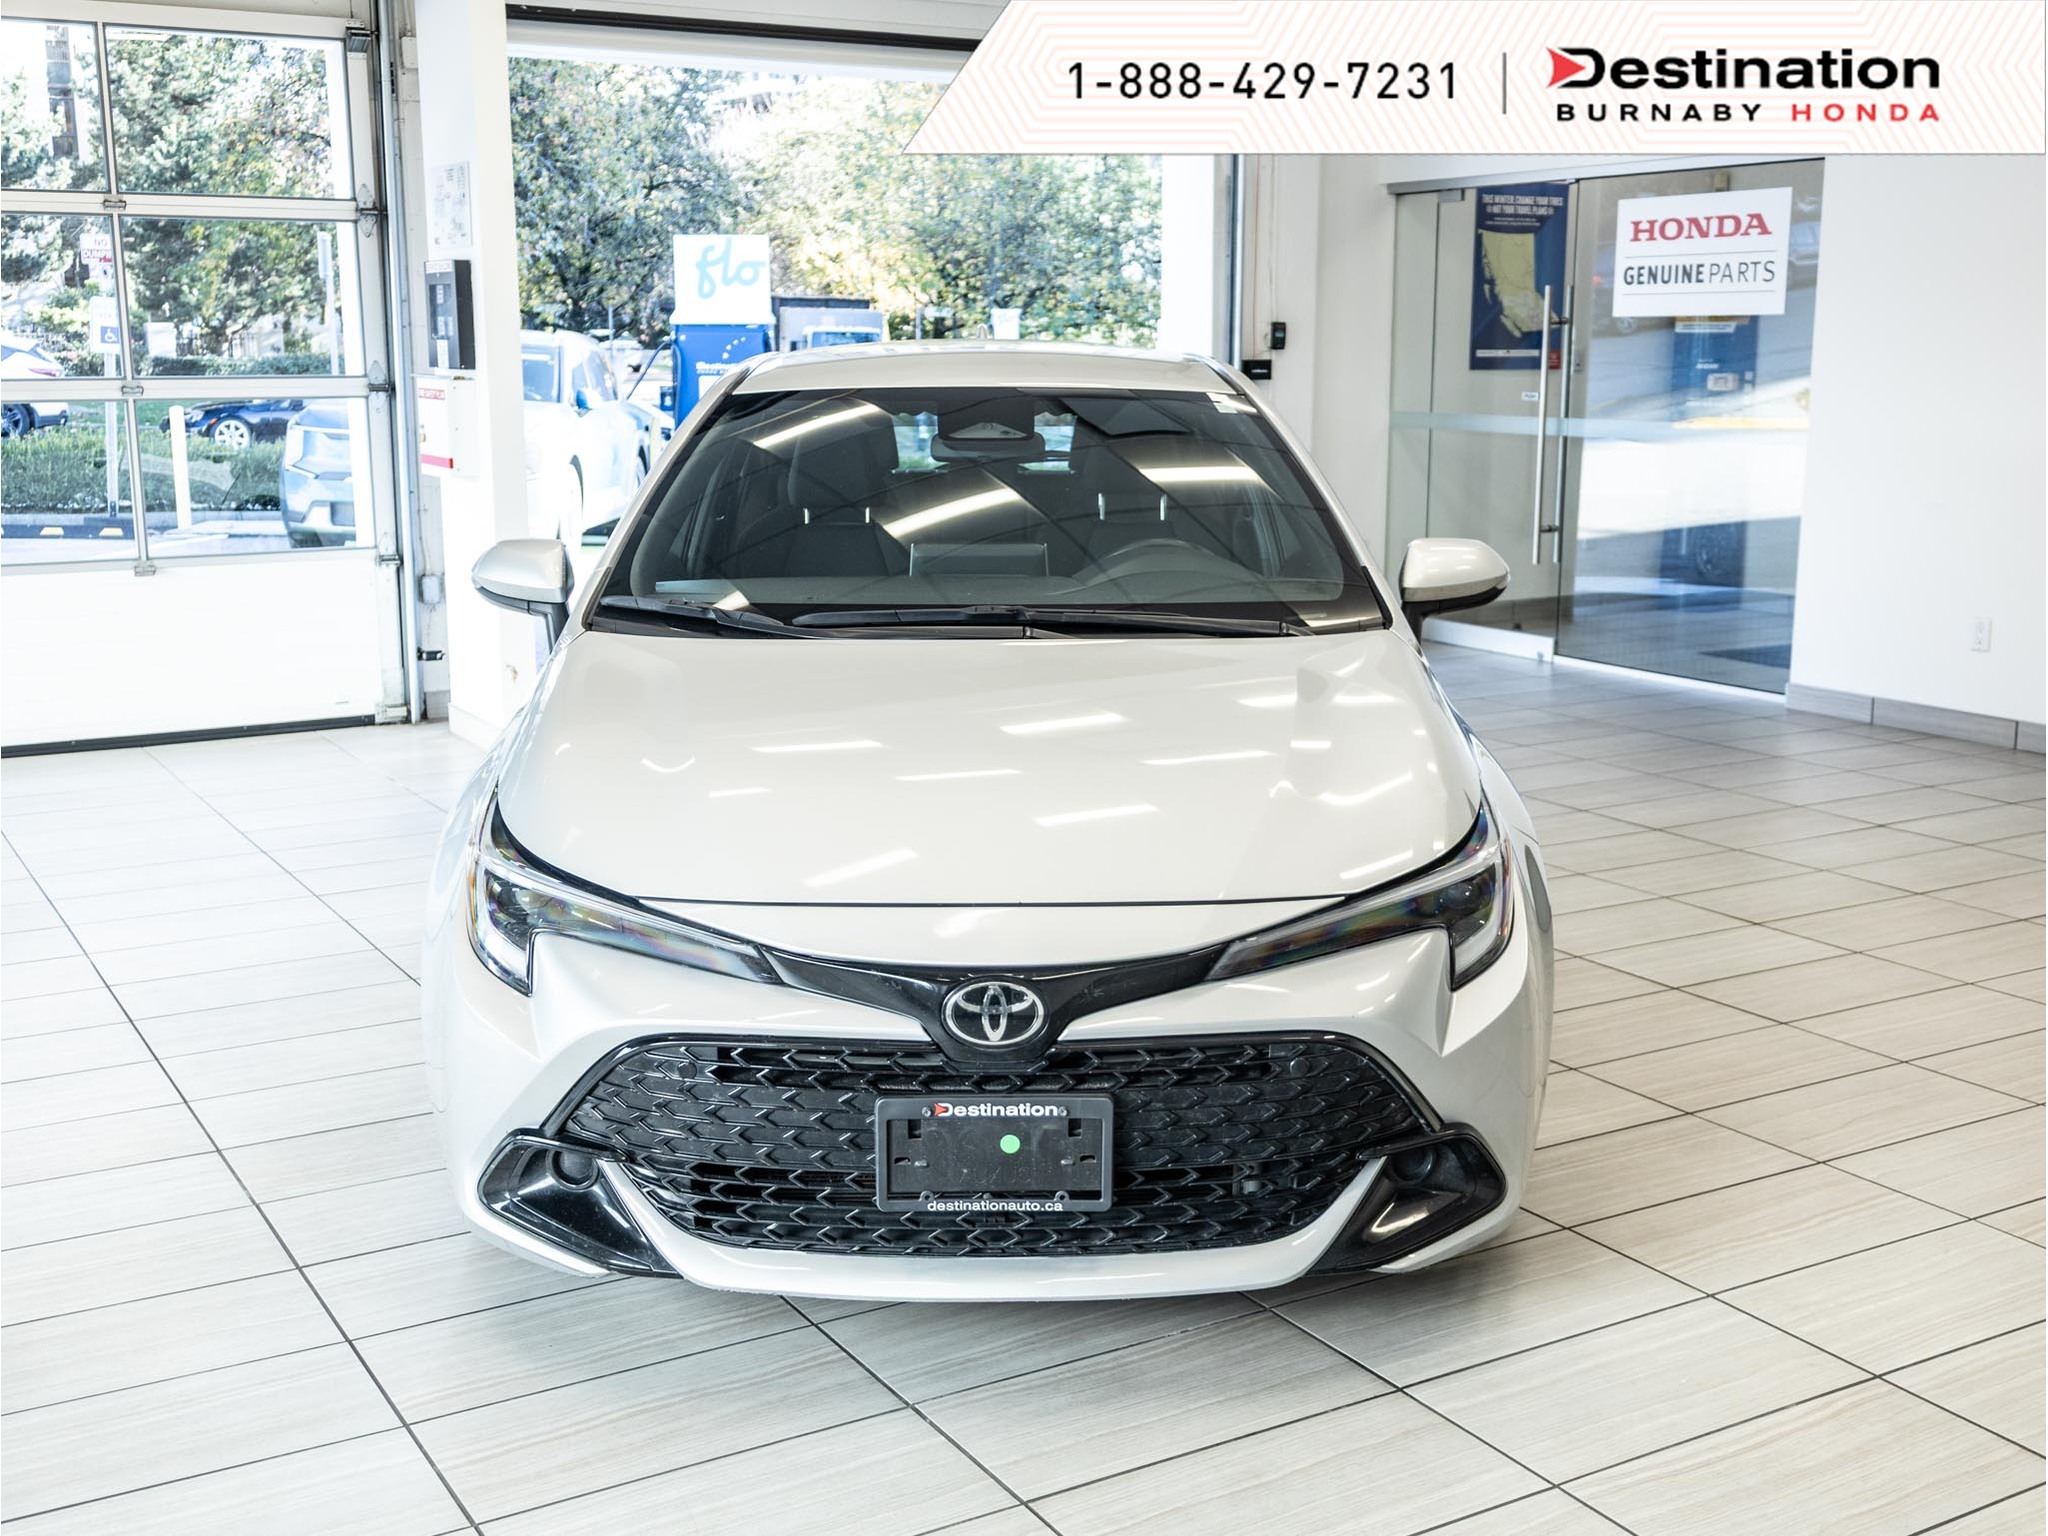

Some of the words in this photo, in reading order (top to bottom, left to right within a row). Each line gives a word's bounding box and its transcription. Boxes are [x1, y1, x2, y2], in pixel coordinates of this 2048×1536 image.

[1630, 212, 1772, 242] HONDA
[695, 238, 766, 299] flo
[1622, 263, 1705, 287] GENUINE
[1708, 260, 1776, 283] PARTS
[935, 1102, 1058, 1117] Destination
[926, 1200, 1064, 1212] destinationauto.ca
